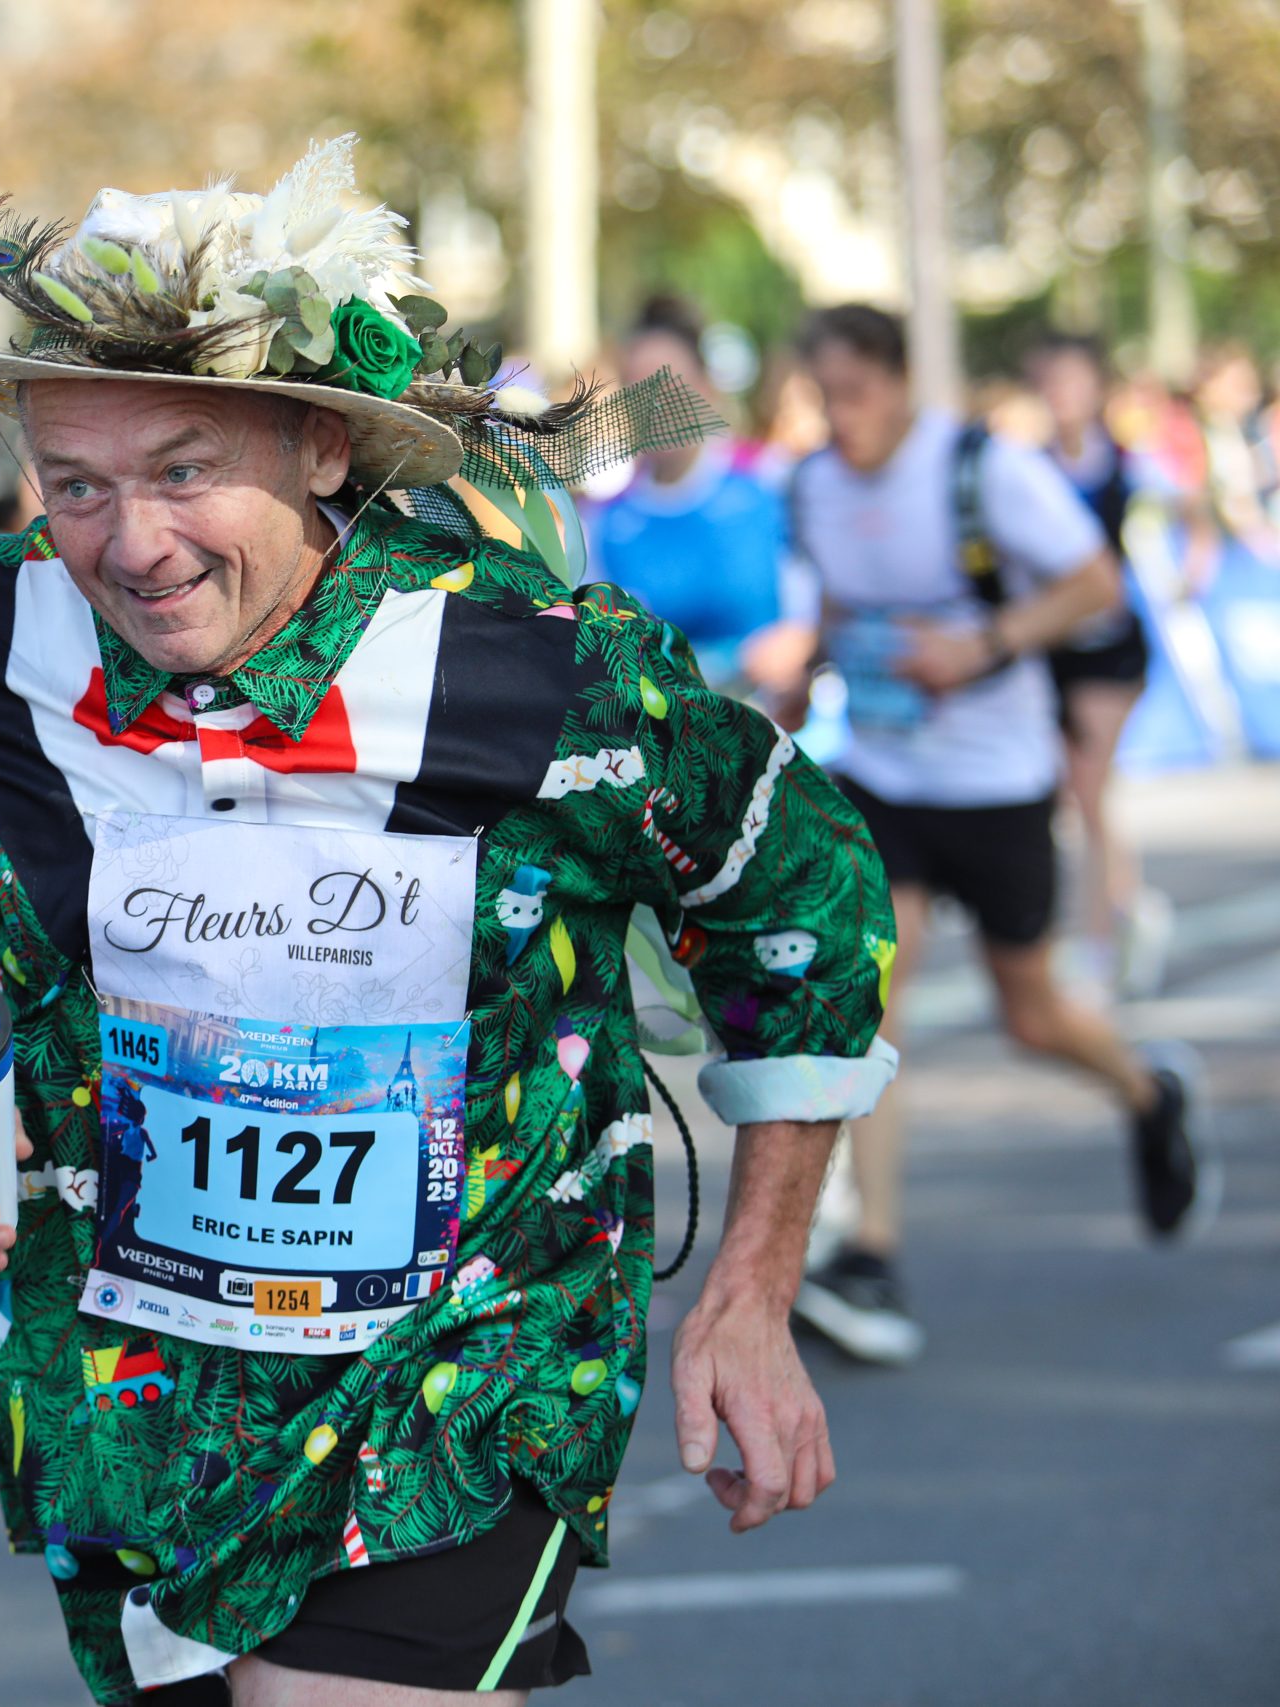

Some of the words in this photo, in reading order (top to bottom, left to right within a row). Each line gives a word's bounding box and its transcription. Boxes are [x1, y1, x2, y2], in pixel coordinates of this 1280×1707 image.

[104, 886, 292, 954] Fleurs
[307, 867, 421, 938] D't
[287, 943, 374, 968] VILLEPARISIS
[108, 1026, 160, 1067] 1H45
[238, 1030, 314, 1047] VREDESTEIN
[273, 1062, 329, 1082] KM
[272, 1080, 328, 1092] PARIS
[263, 1096, 299, 1110] édition
[433, 1118, 457, 1140] 12
[428, 1141, 458, 1156] OCT.
[181, 1115, 376, 1206] 1127
[427, 1157, 458, 1180] 20
[426, 1181, 457, 1202] 25
[191, 1215, 241, 1241] ERIC
[246, 1225, 275, 1244] LE
[281, 1229, 354, 1247] SAPIN
[116, 1245, 204, 1281] VREDESTEIN
[142, 1267, 175, 1282] PNEUS
[266, 1289, 310, 1311] 1254
